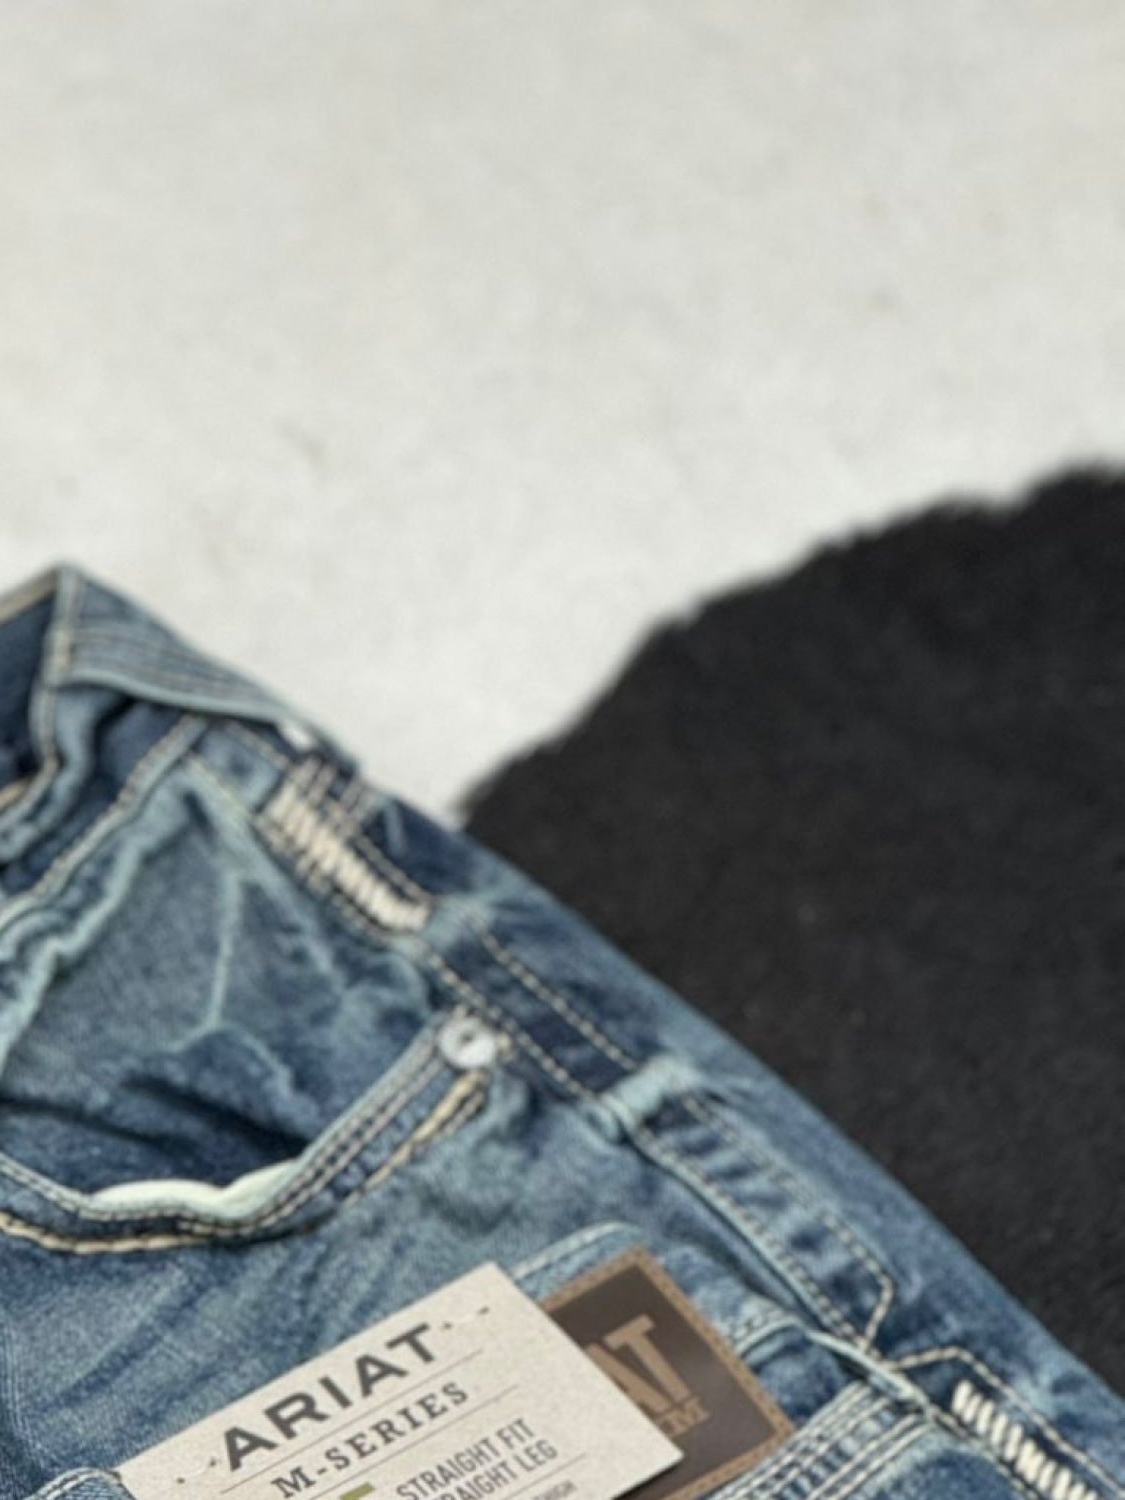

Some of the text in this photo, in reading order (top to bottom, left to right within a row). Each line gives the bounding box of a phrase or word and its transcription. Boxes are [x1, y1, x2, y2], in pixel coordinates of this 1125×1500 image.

[224, 1322, 436, 1472] ARIAT
[498, 1418, 535, 1450] FIT
[270, 1382, 469, 1499] M-SERIES
[518, 1439, 558, 1472] LEG
